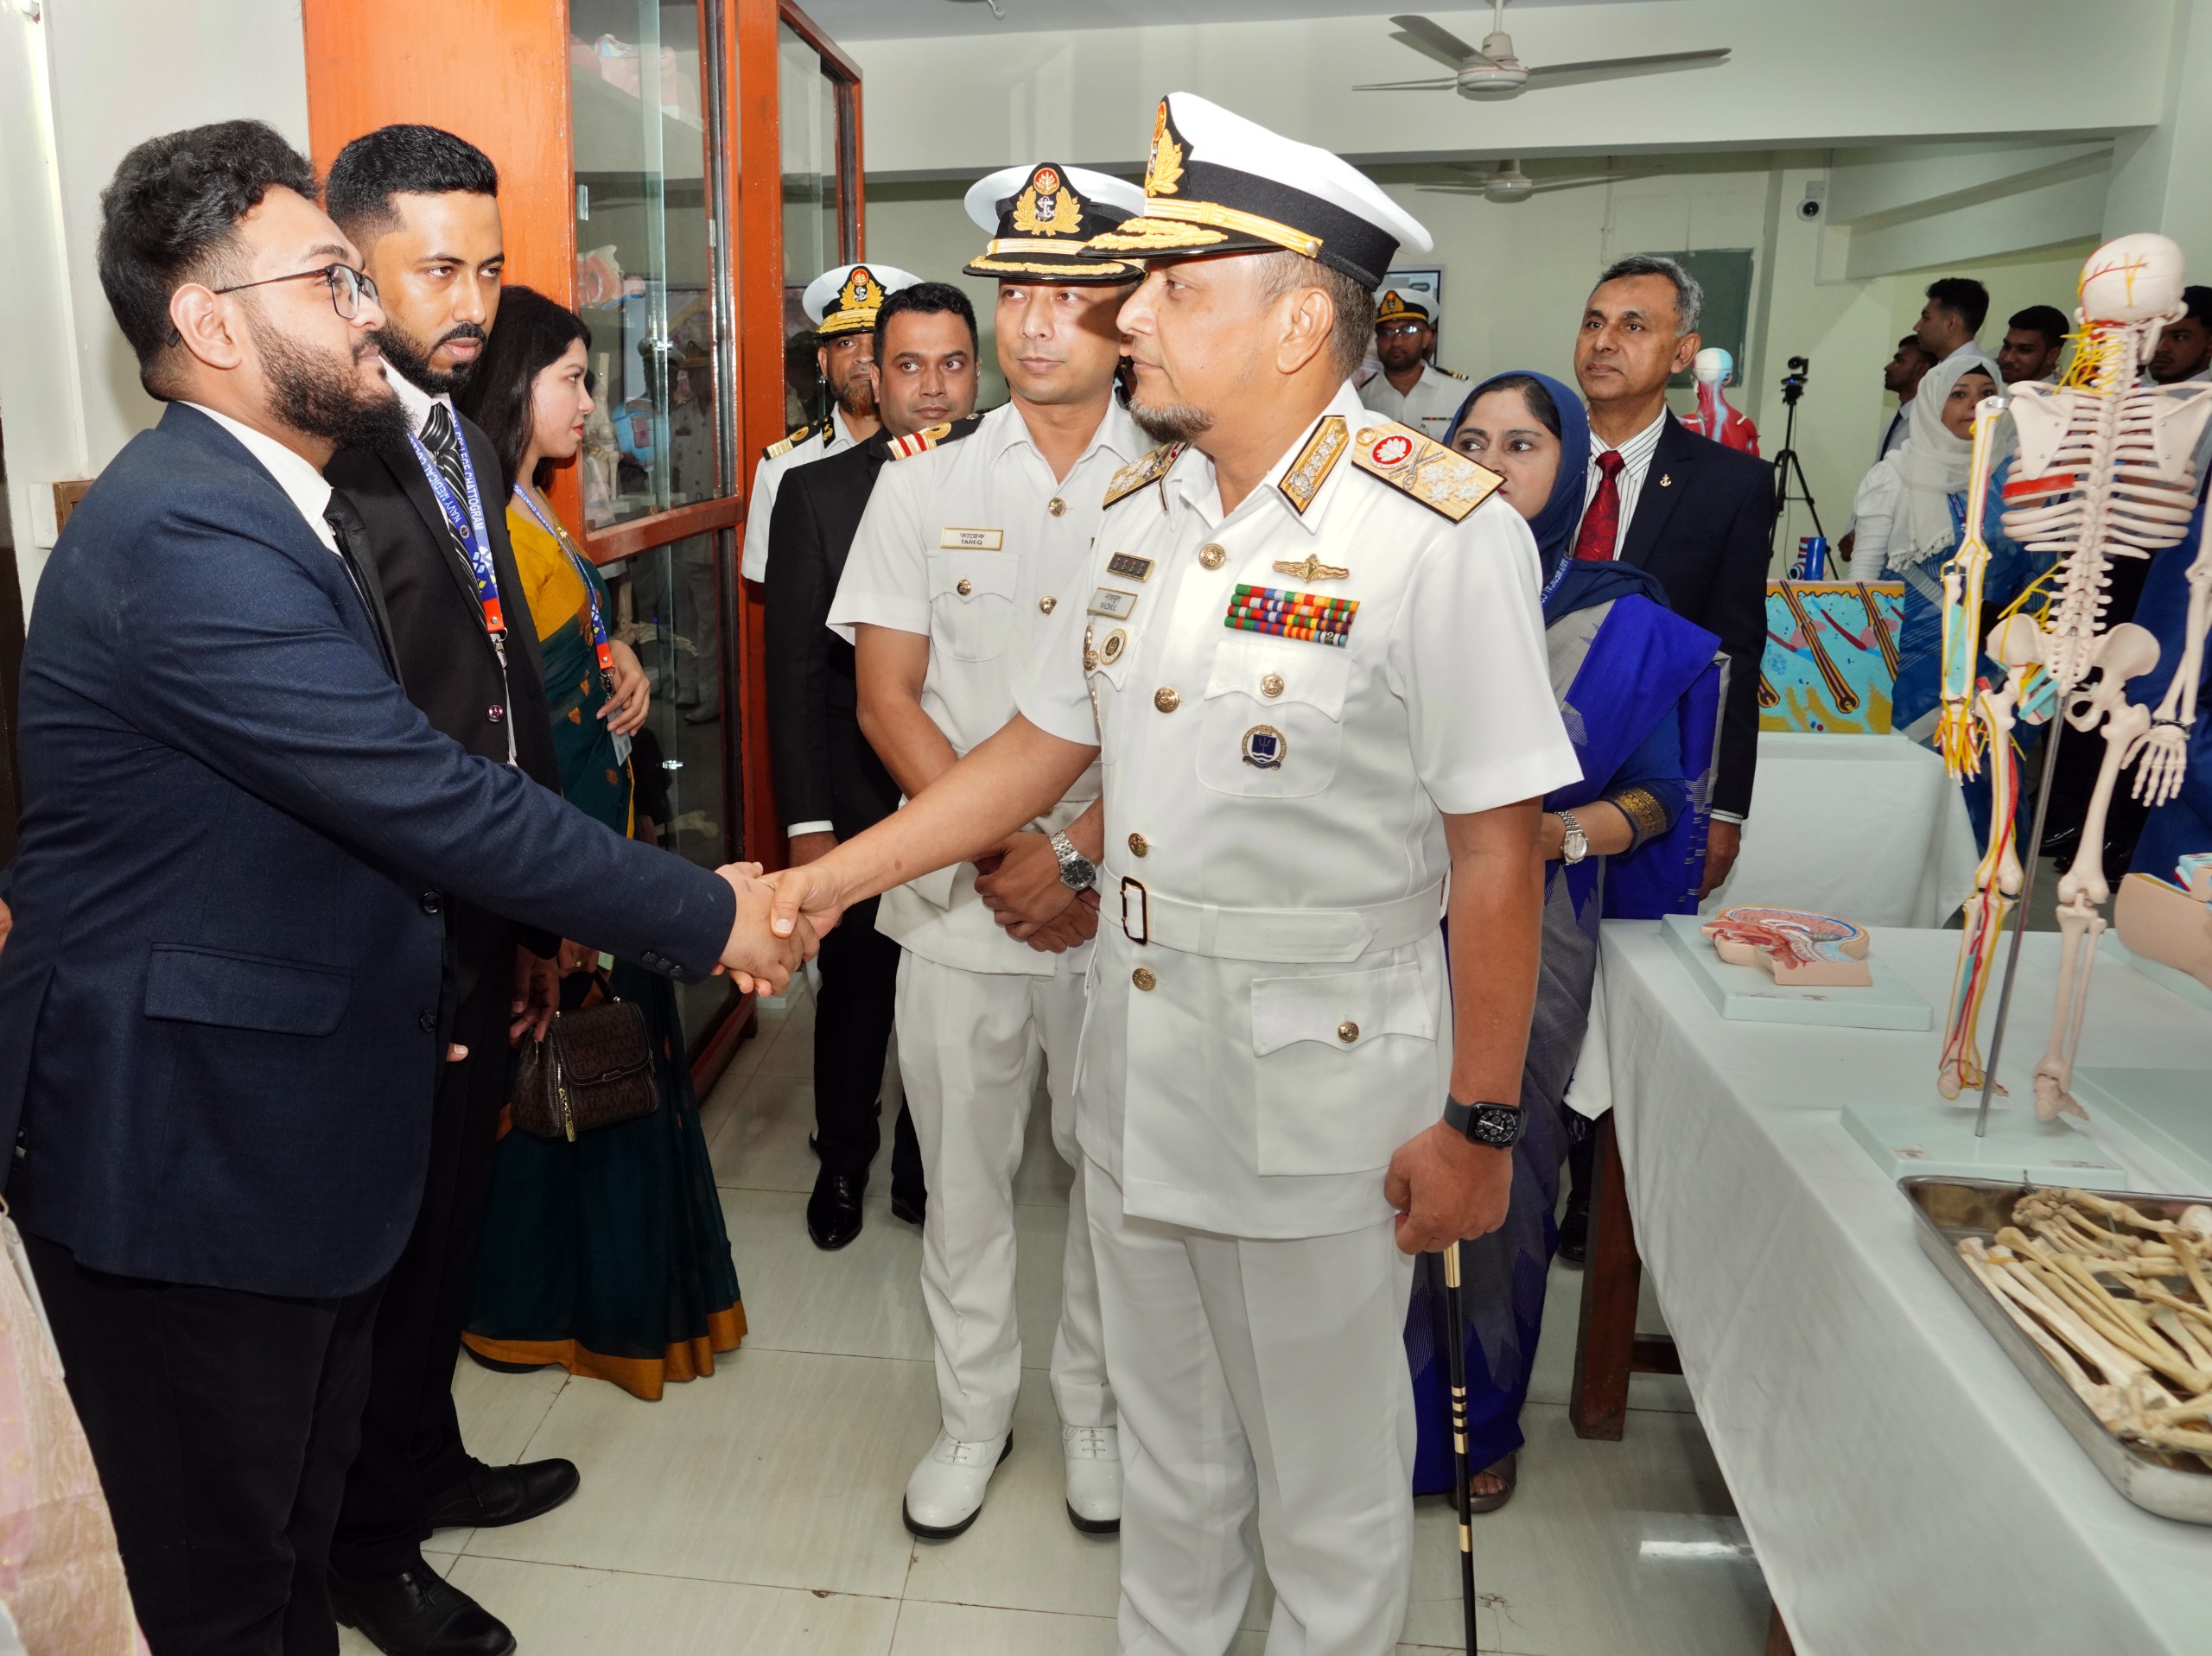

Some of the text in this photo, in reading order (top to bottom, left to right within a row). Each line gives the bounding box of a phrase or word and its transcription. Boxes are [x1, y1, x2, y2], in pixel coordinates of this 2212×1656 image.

[424, 464, 451, 502] MEDICAL
[513, 485, 537, 511] CHATTOG
[445, 500, 462, 523] NAVY
[465, 472, 485, 530] CHATTOGRAM
